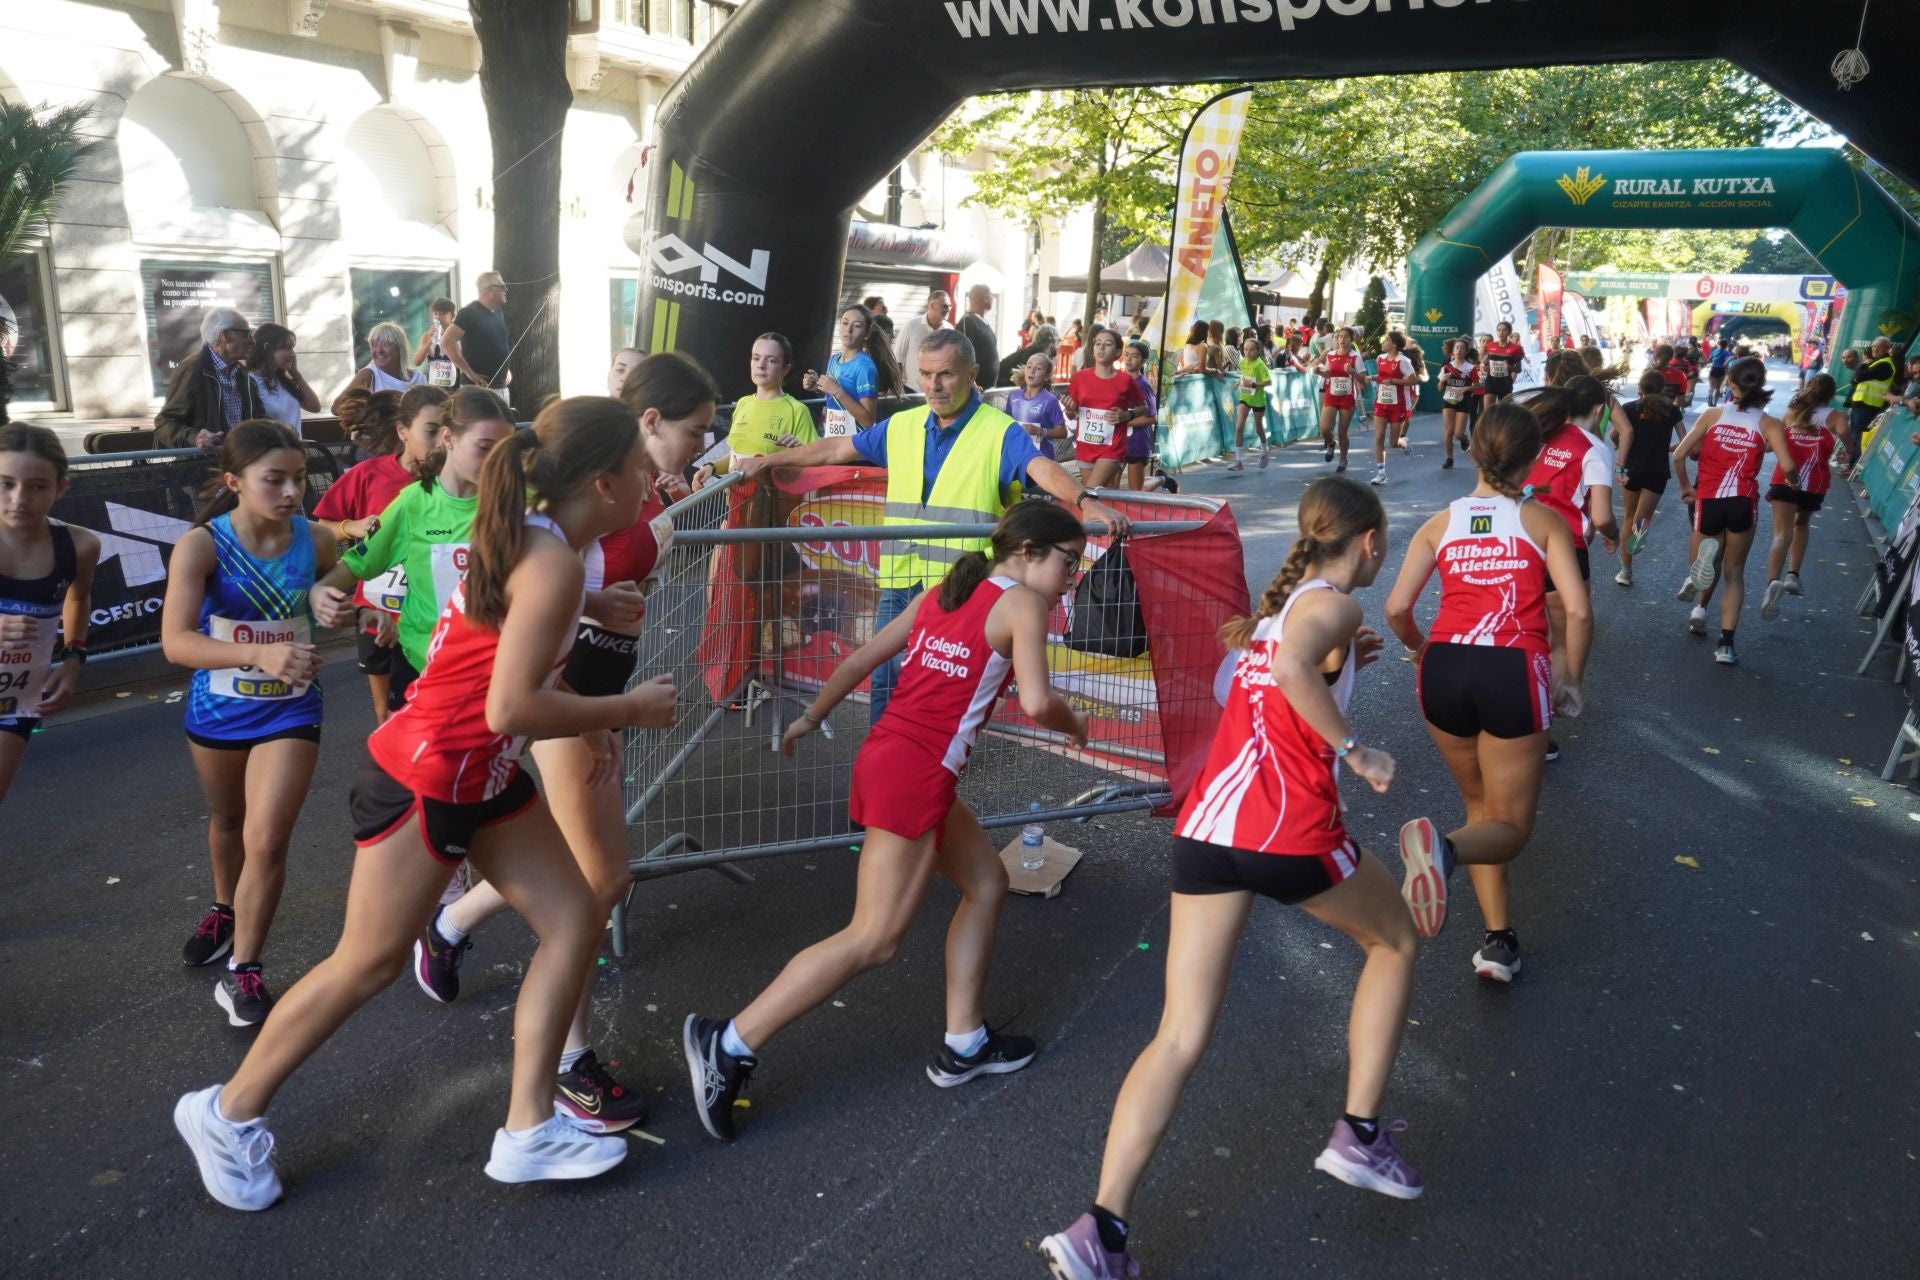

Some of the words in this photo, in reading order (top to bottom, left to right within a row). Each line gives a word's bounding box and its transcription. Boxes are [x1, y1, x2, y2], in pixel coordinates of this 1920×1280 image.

[1613, 179, 1686, 195] RURAL
[1692, 177, 1776, 194] KUTXA
[1738, 200, 1773, 208] SOCIAL
[1178, 149, 1220, 280] ANETO
[1696, 275, 1749, 298] Bilbao
[1743, 302, 1770, 314] BM
[829, 423, 845, 435] 680
[1086, 421, 1104, 432] 751
[1714, 427, 1748, 439] Bilbao
[1714, 434, 1757, 448] Atletismo
[1547, 447, 1572, 460] Colegio
[1445, 544, 1505, 561] Bilbao
[1448, 558, 1529, 574] Atletismo
[1462, 573, 1513, 586] Santutxu
[89, 597, 163, 627] CESTO
[234, 624, 294, 645] Bilbao
[925, 636, 970, 659] Colegio
[921, 652, 968, 678] Vizcaya
[259, 683, 288, 695] BM
